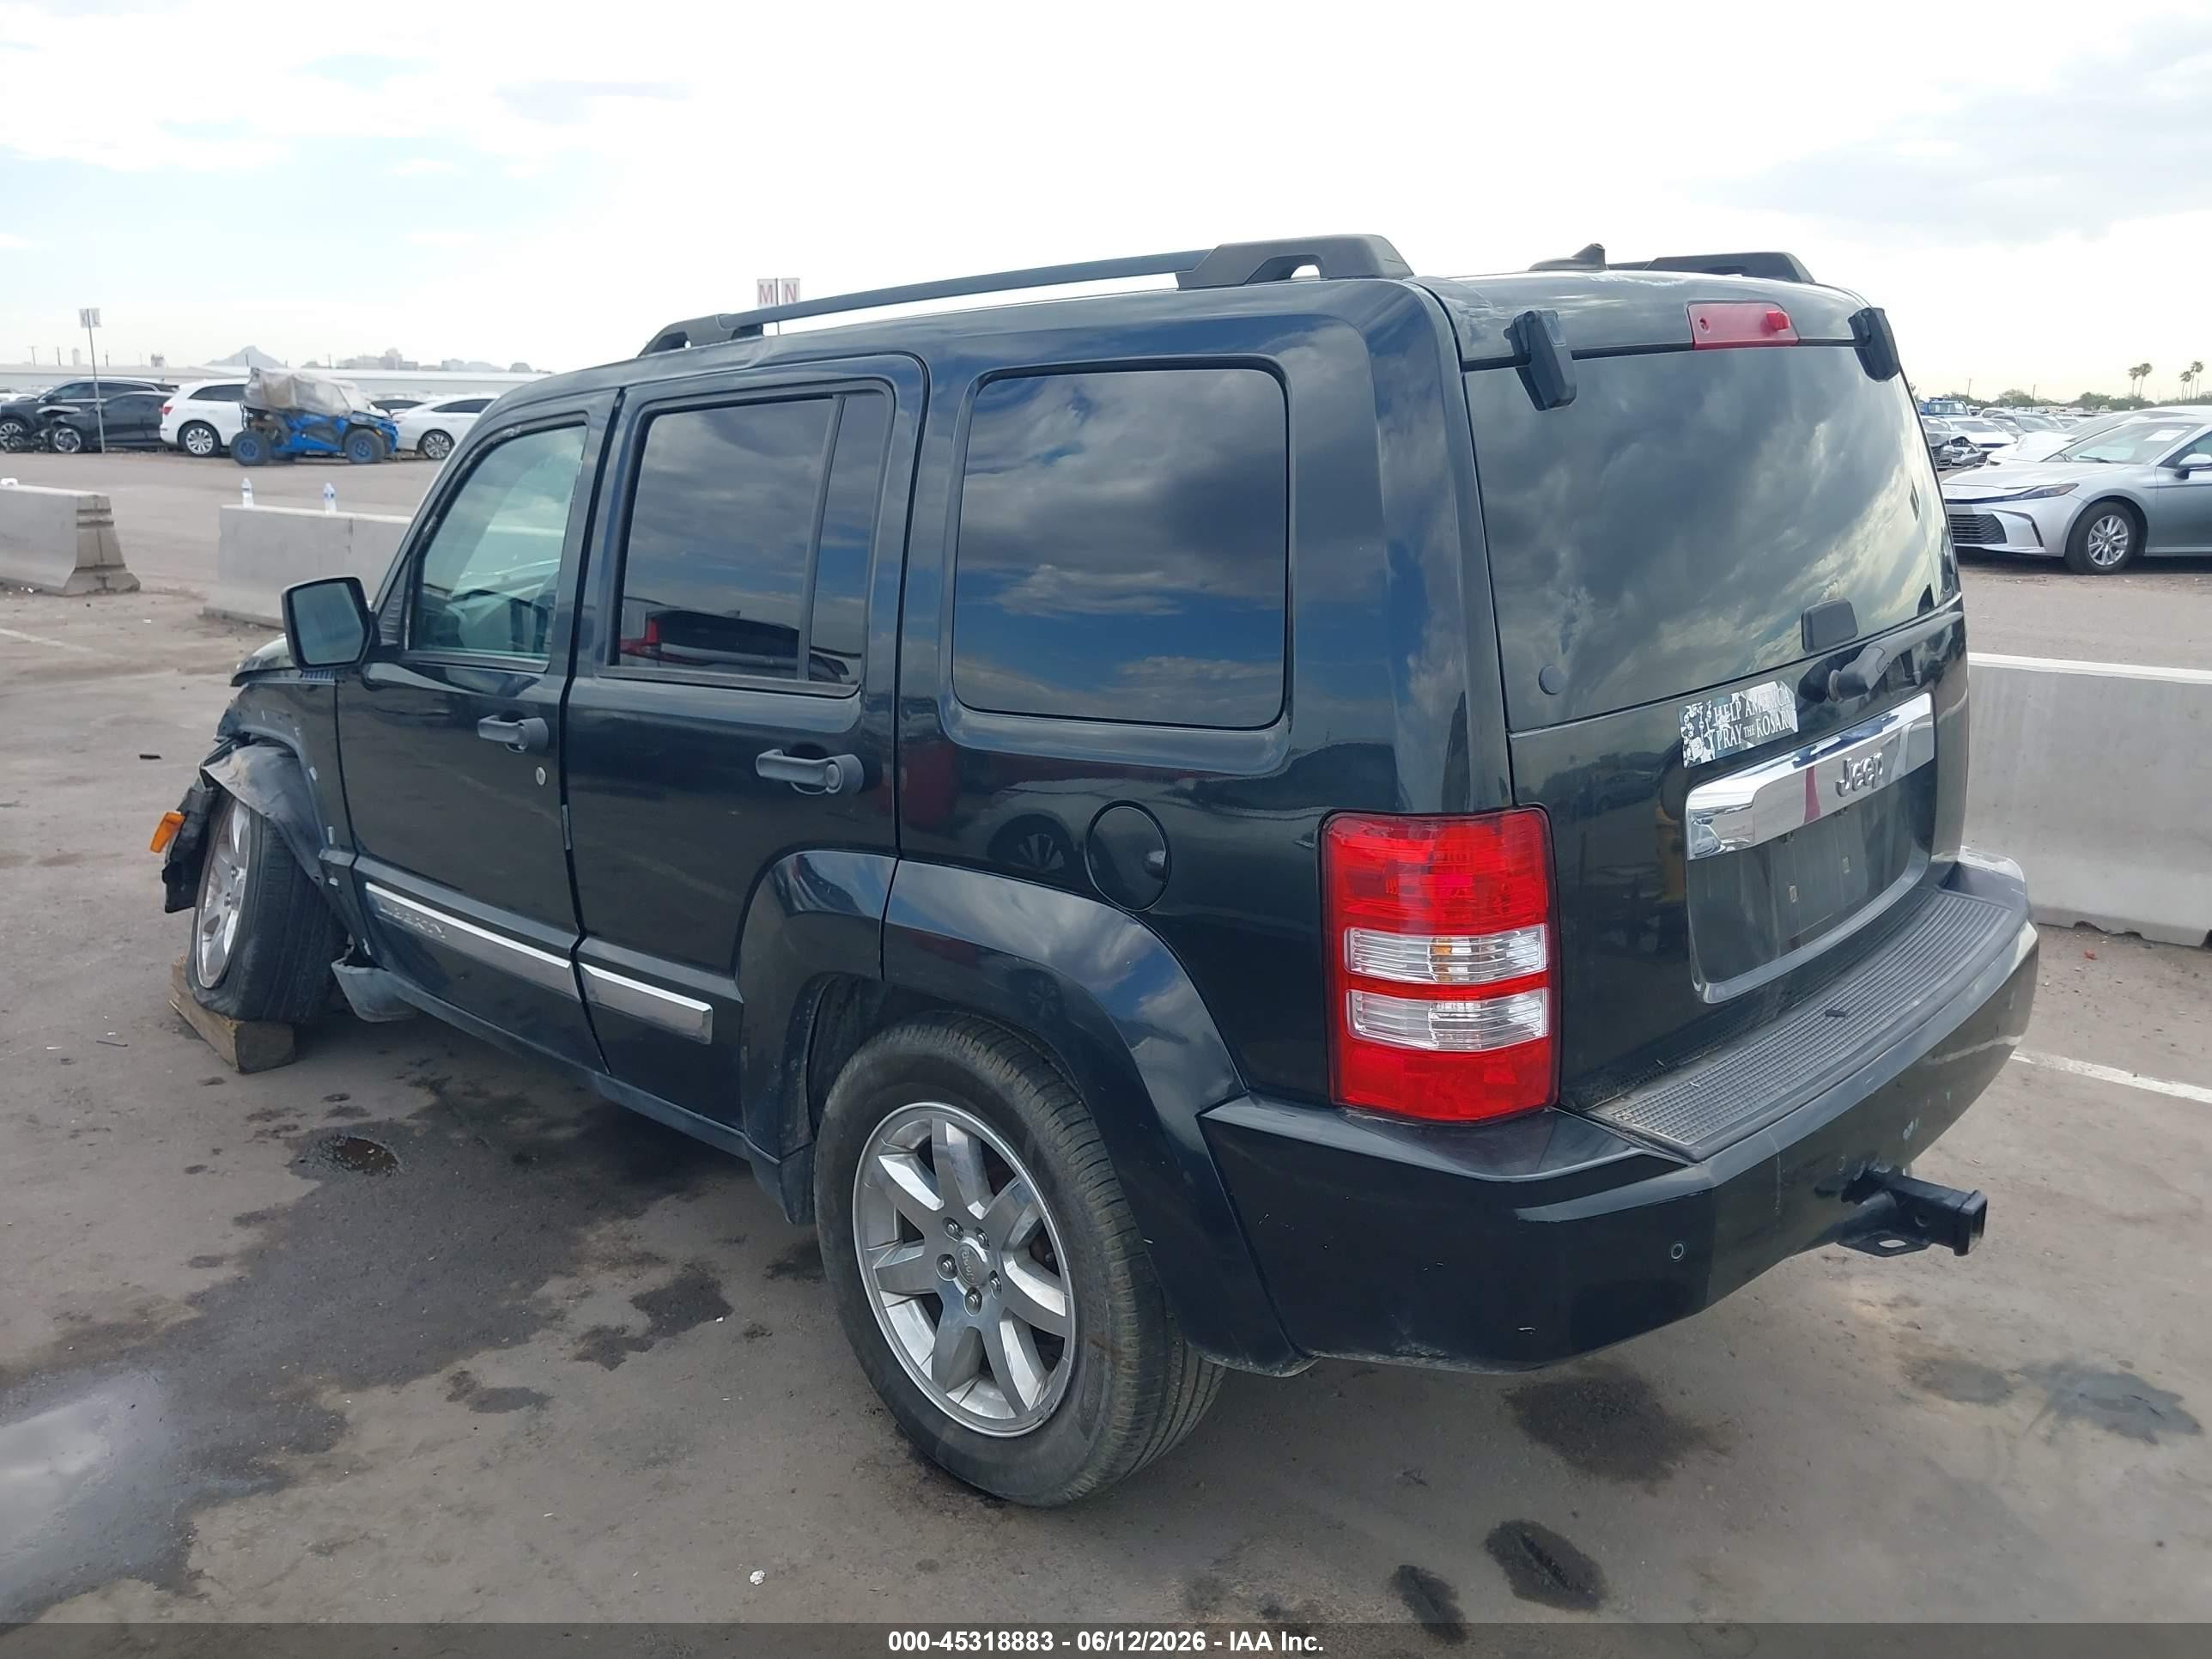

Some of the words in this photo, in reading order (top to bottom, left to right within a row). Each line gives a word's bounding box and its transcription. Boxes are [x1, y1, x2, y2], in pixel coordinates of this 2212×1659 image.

[759, 284, 773, 304] M
[785, 283, 797, 303] N
[1713, 700, 1742, 723] HELP
[1717, 723, 1743, 750] PRAY
[1743, 725, 1756, 738] THE
[1754, 708, 1793, 738] ROSARY
[1834, 752, 1883, 798] Jeep
